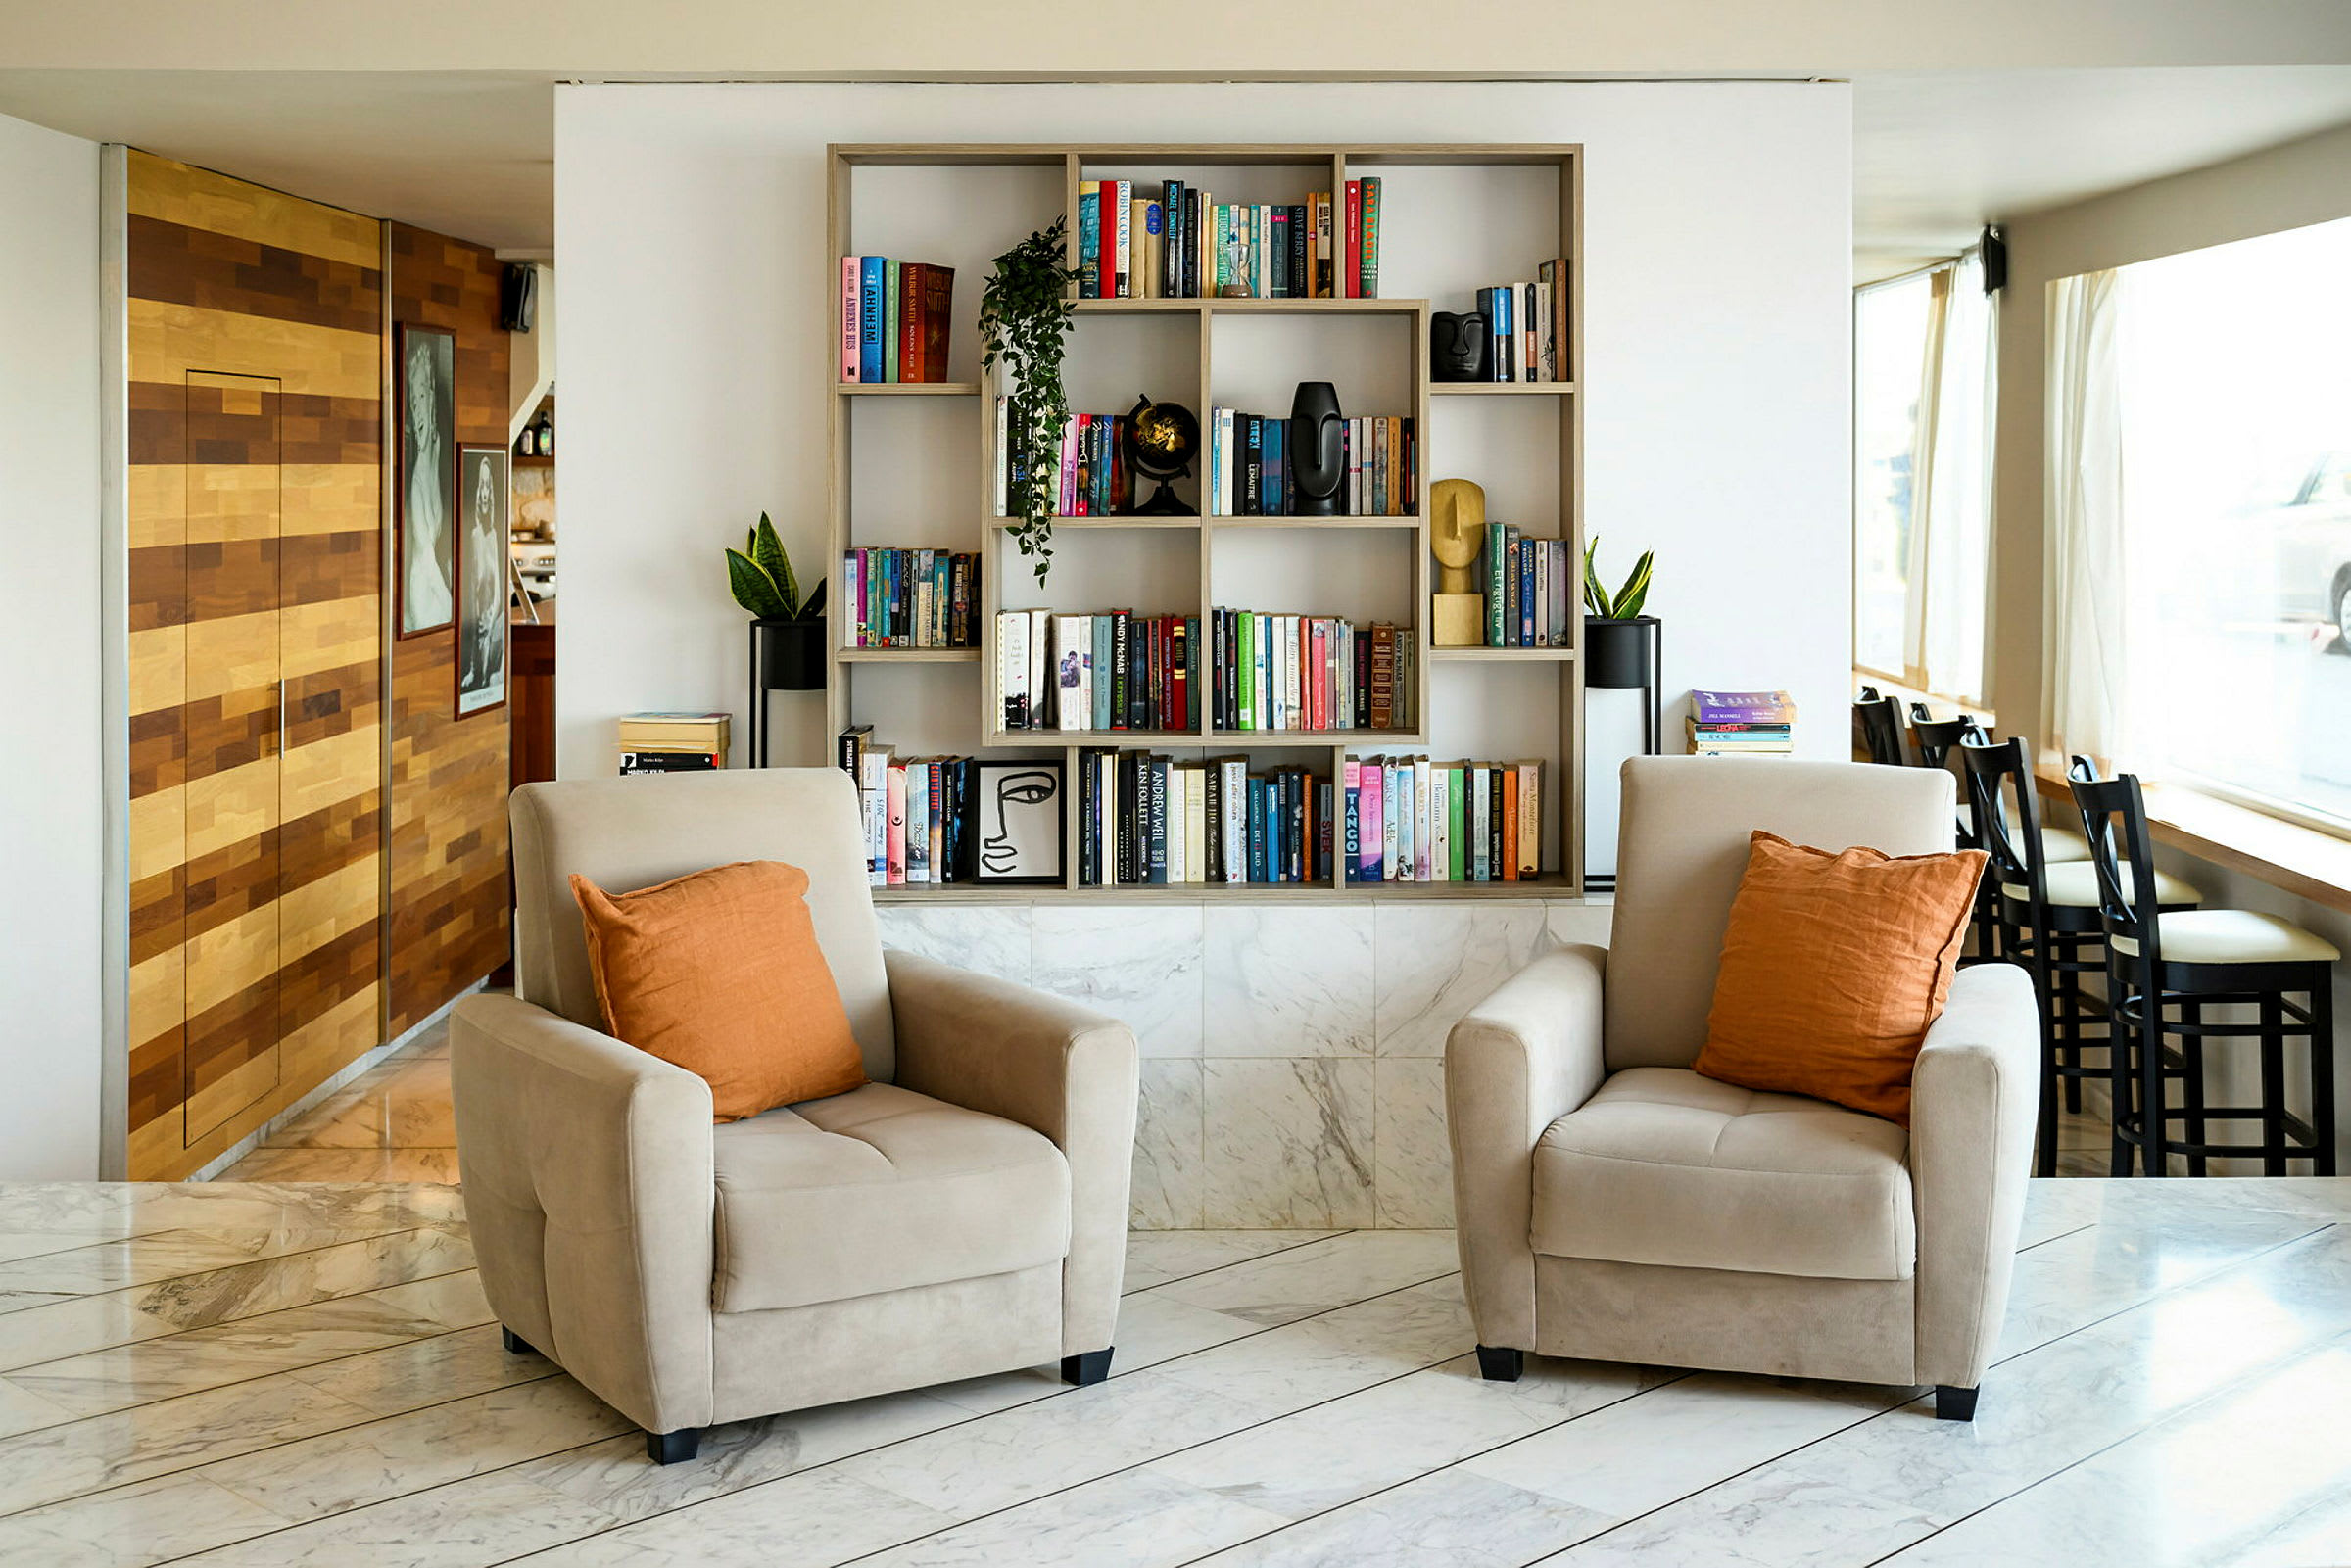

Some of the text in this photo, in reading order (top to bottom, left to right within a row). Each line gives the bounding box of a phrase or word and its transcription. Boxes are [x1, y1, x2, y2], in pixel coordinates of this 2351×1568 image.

[1366, 183, 1376, 214] SARA
[1119, 183, 1128, 247] ROBIN COOK
[1294, 207, 1304, 257] STEVE BERRY
[908, 267, 917, 297] WILBUR
[908, 298, 917, 322] SMITH
[845, 334, 856, 351] HUS
[1494, 570, 1504, 582] Et
[1492, 583, 1504, 615] rigtigt
[1117, 617, 1126, 642] ANDY
[1117, 643, 1126, 674] McNAB
[1138, 765, 1148, 784] KEN
[1208, 772, 1217, 805] SARAH
[1138, 786, 1148, 825] FOLLETT
[1152, 771, 1164, 841] ANDREW WEIL
[1208, 807, 1217, 824] JIO
[1346, 792, 1359, 853] TANGO
